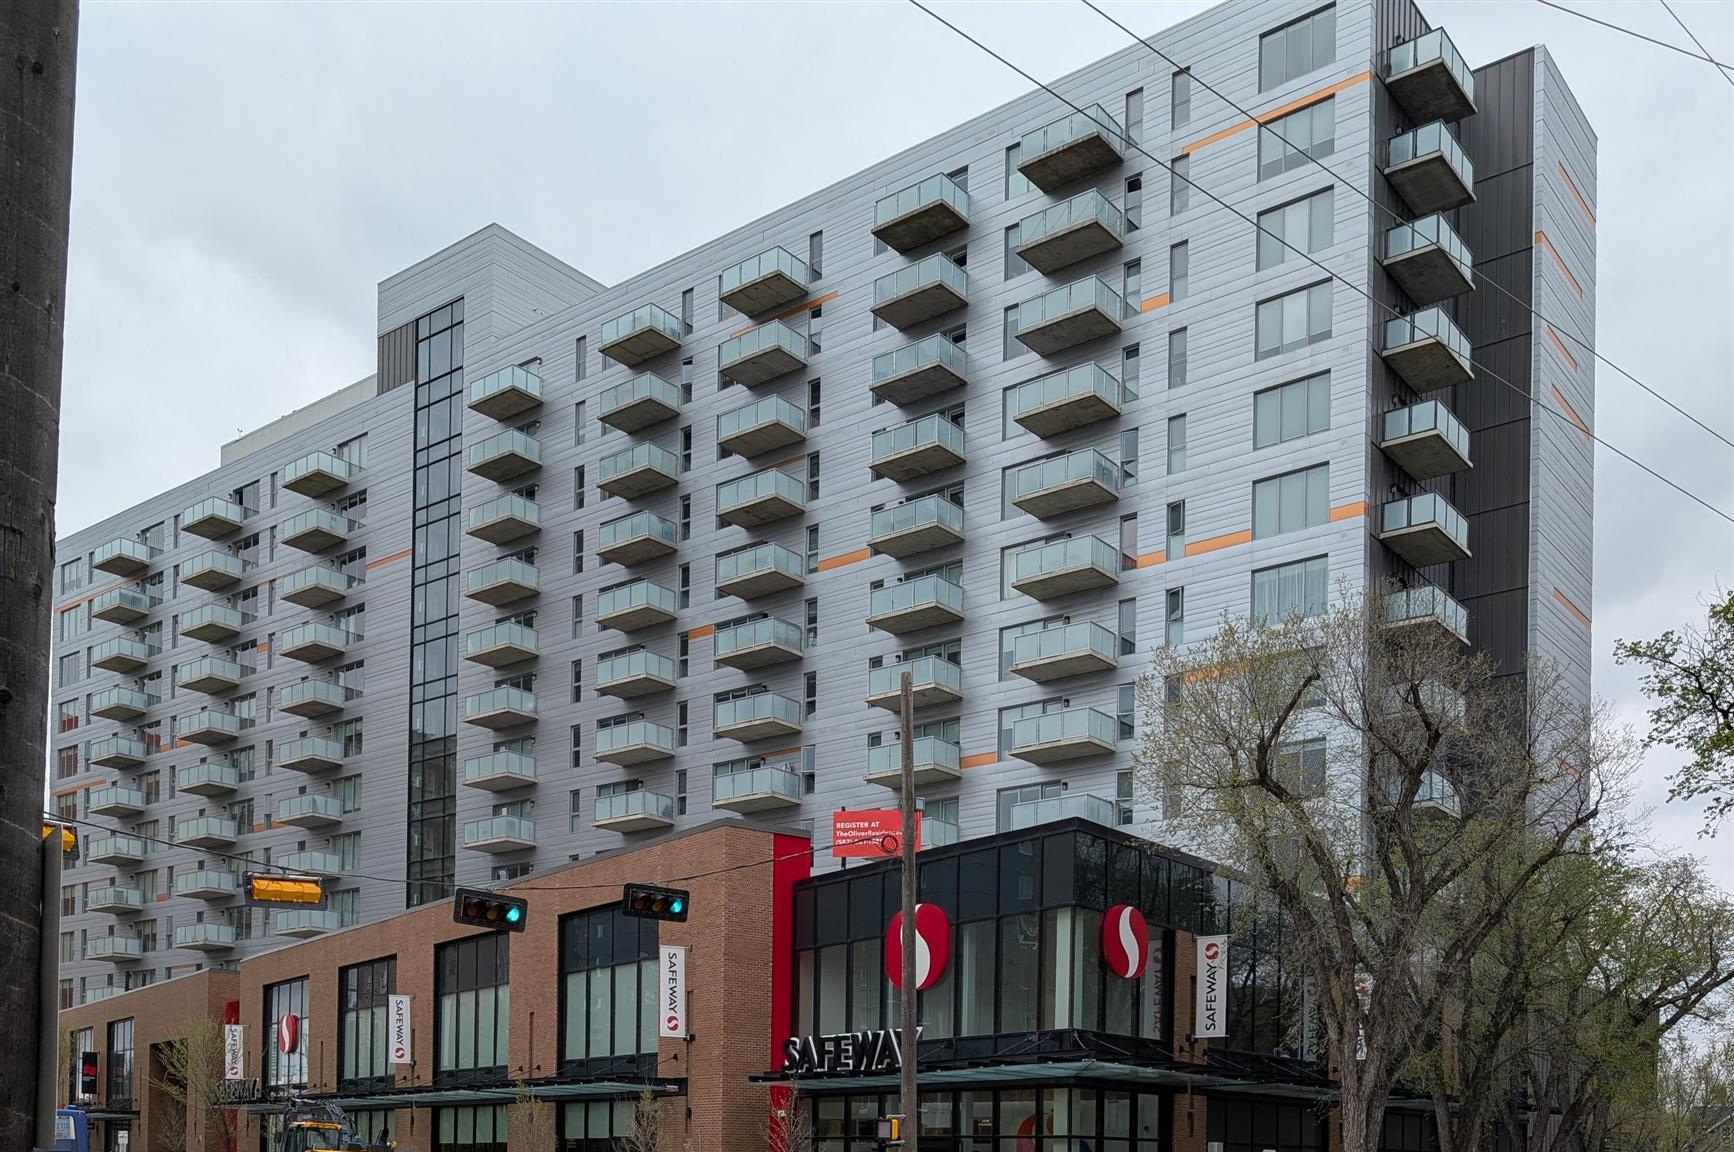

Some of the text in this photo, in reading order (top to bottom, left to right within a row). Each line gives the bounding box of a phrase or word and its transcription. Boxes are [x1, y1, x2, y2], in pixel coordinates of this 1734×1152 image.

[668, 952, 678, 1014] SAFEWAY
[1205, 963, 1217, 1031] SAFEWAY
[230, 1028, 238, 1066] SAFEWAY
[395, 1000, 404, 1046] SAFEWAY
